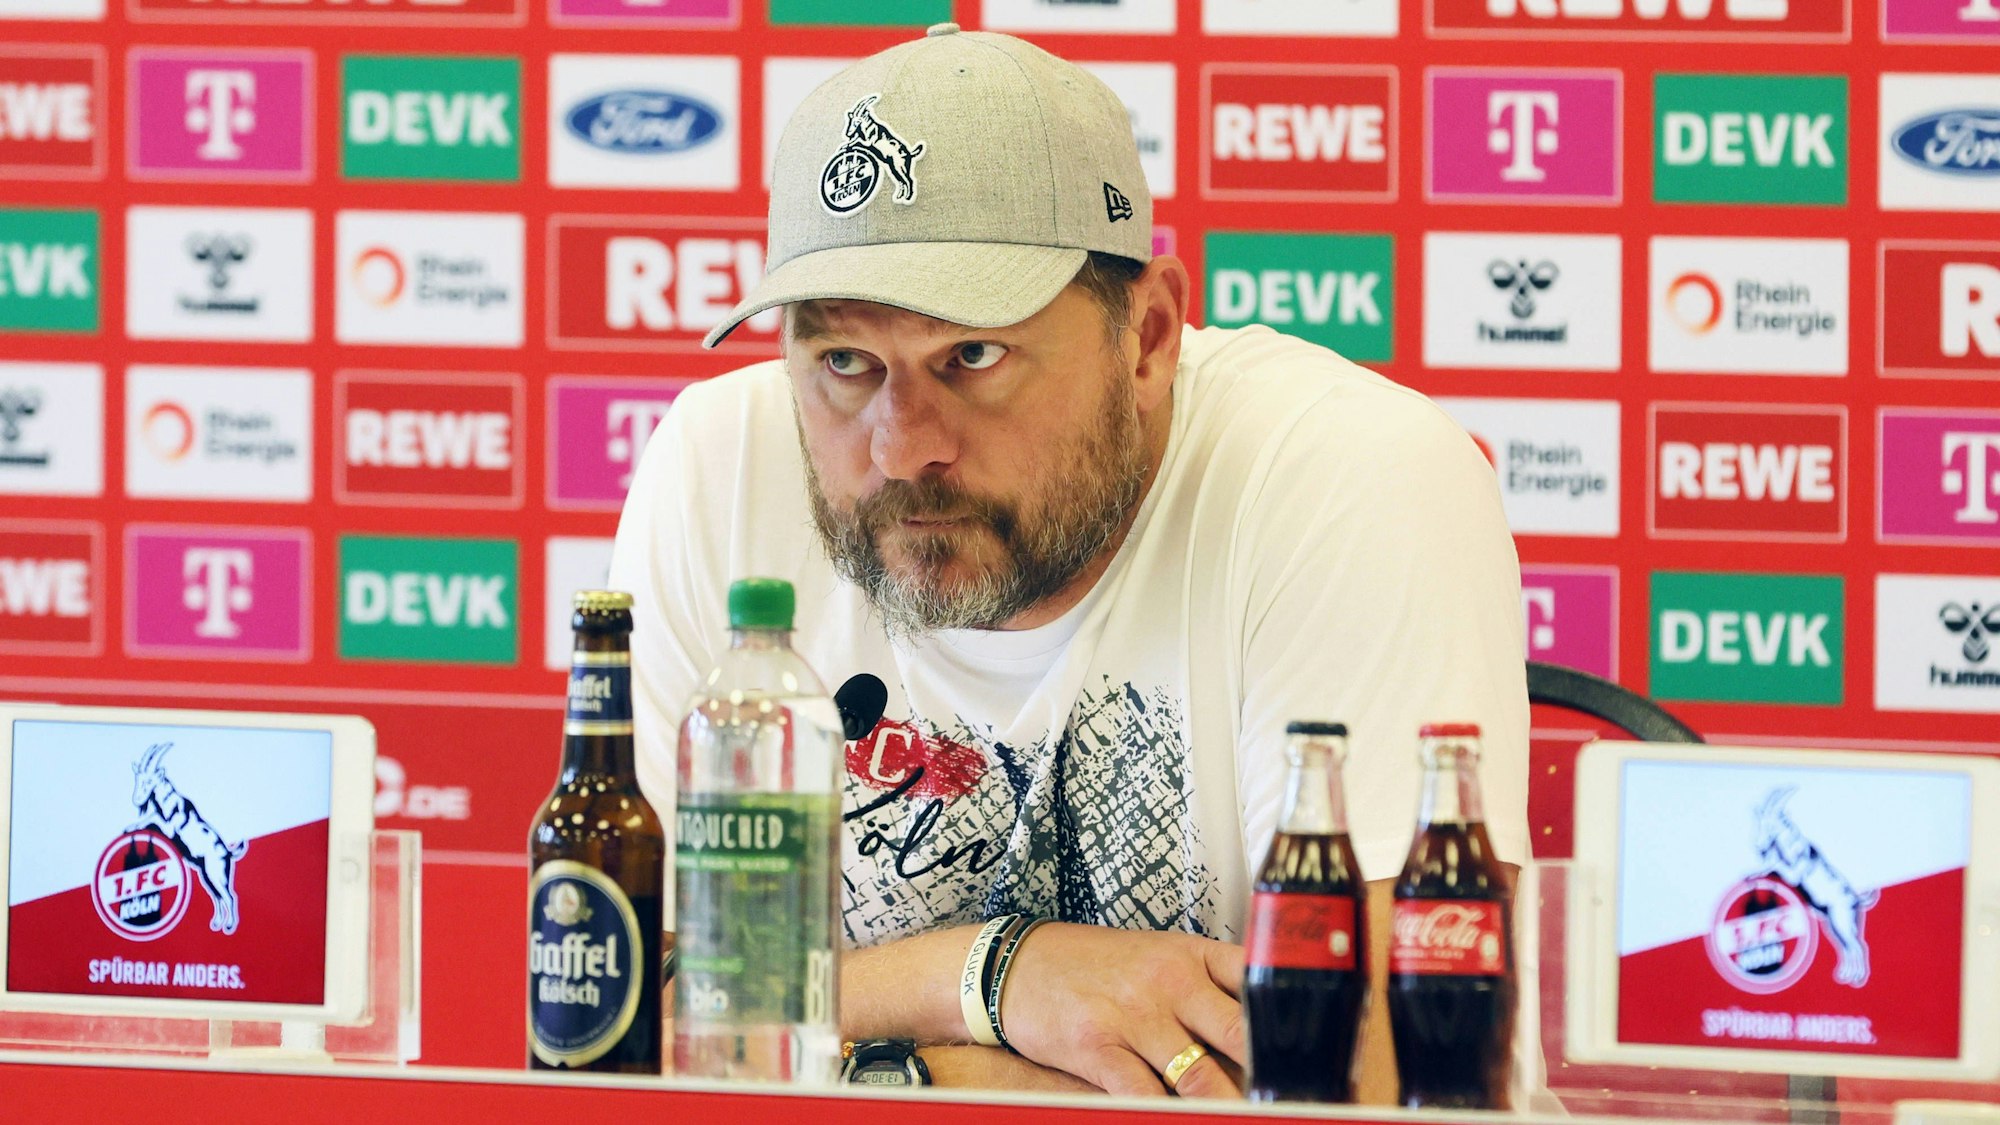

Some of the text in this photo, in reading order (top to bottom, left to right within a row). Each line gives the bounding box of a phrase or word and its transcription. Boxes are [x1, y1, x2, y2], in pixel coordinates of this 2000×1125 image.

[0, 83, 89, 139] WE
[348, 91, 511, 145] DEVK
[589, 92, 697, 147] Ford
[1213, 103, 1385, 162] REWE
[1488, 91, 1559, 182] T
[1663, 113, 1835, 167] DEVK
[0, 244, 89, 297] VK
[1214, 270, 1382, 324] DEVK
[1735, 281, 1810, 303] Rhein
[1477, 322, 1568, 343] hummel
[1735, 308, 1836, 335] Energie
[344, 409, 512, 468] REWE
[1508, 441, 1582, 464] Rhein
[1508, 470, 1607, 496] Energie
[1660, 442, 1835, 502] REWE
[346, 571, 507, 627] DEVK
[1660, 610, 1830, 666] DEVK
[846, 727, 915, 785] C
[115, 866, 166, 897] 1.FC
[120, 895, 160, 920] KÖLN
[88, 956, 245, 989] SPÜRBAR ANDERS.
